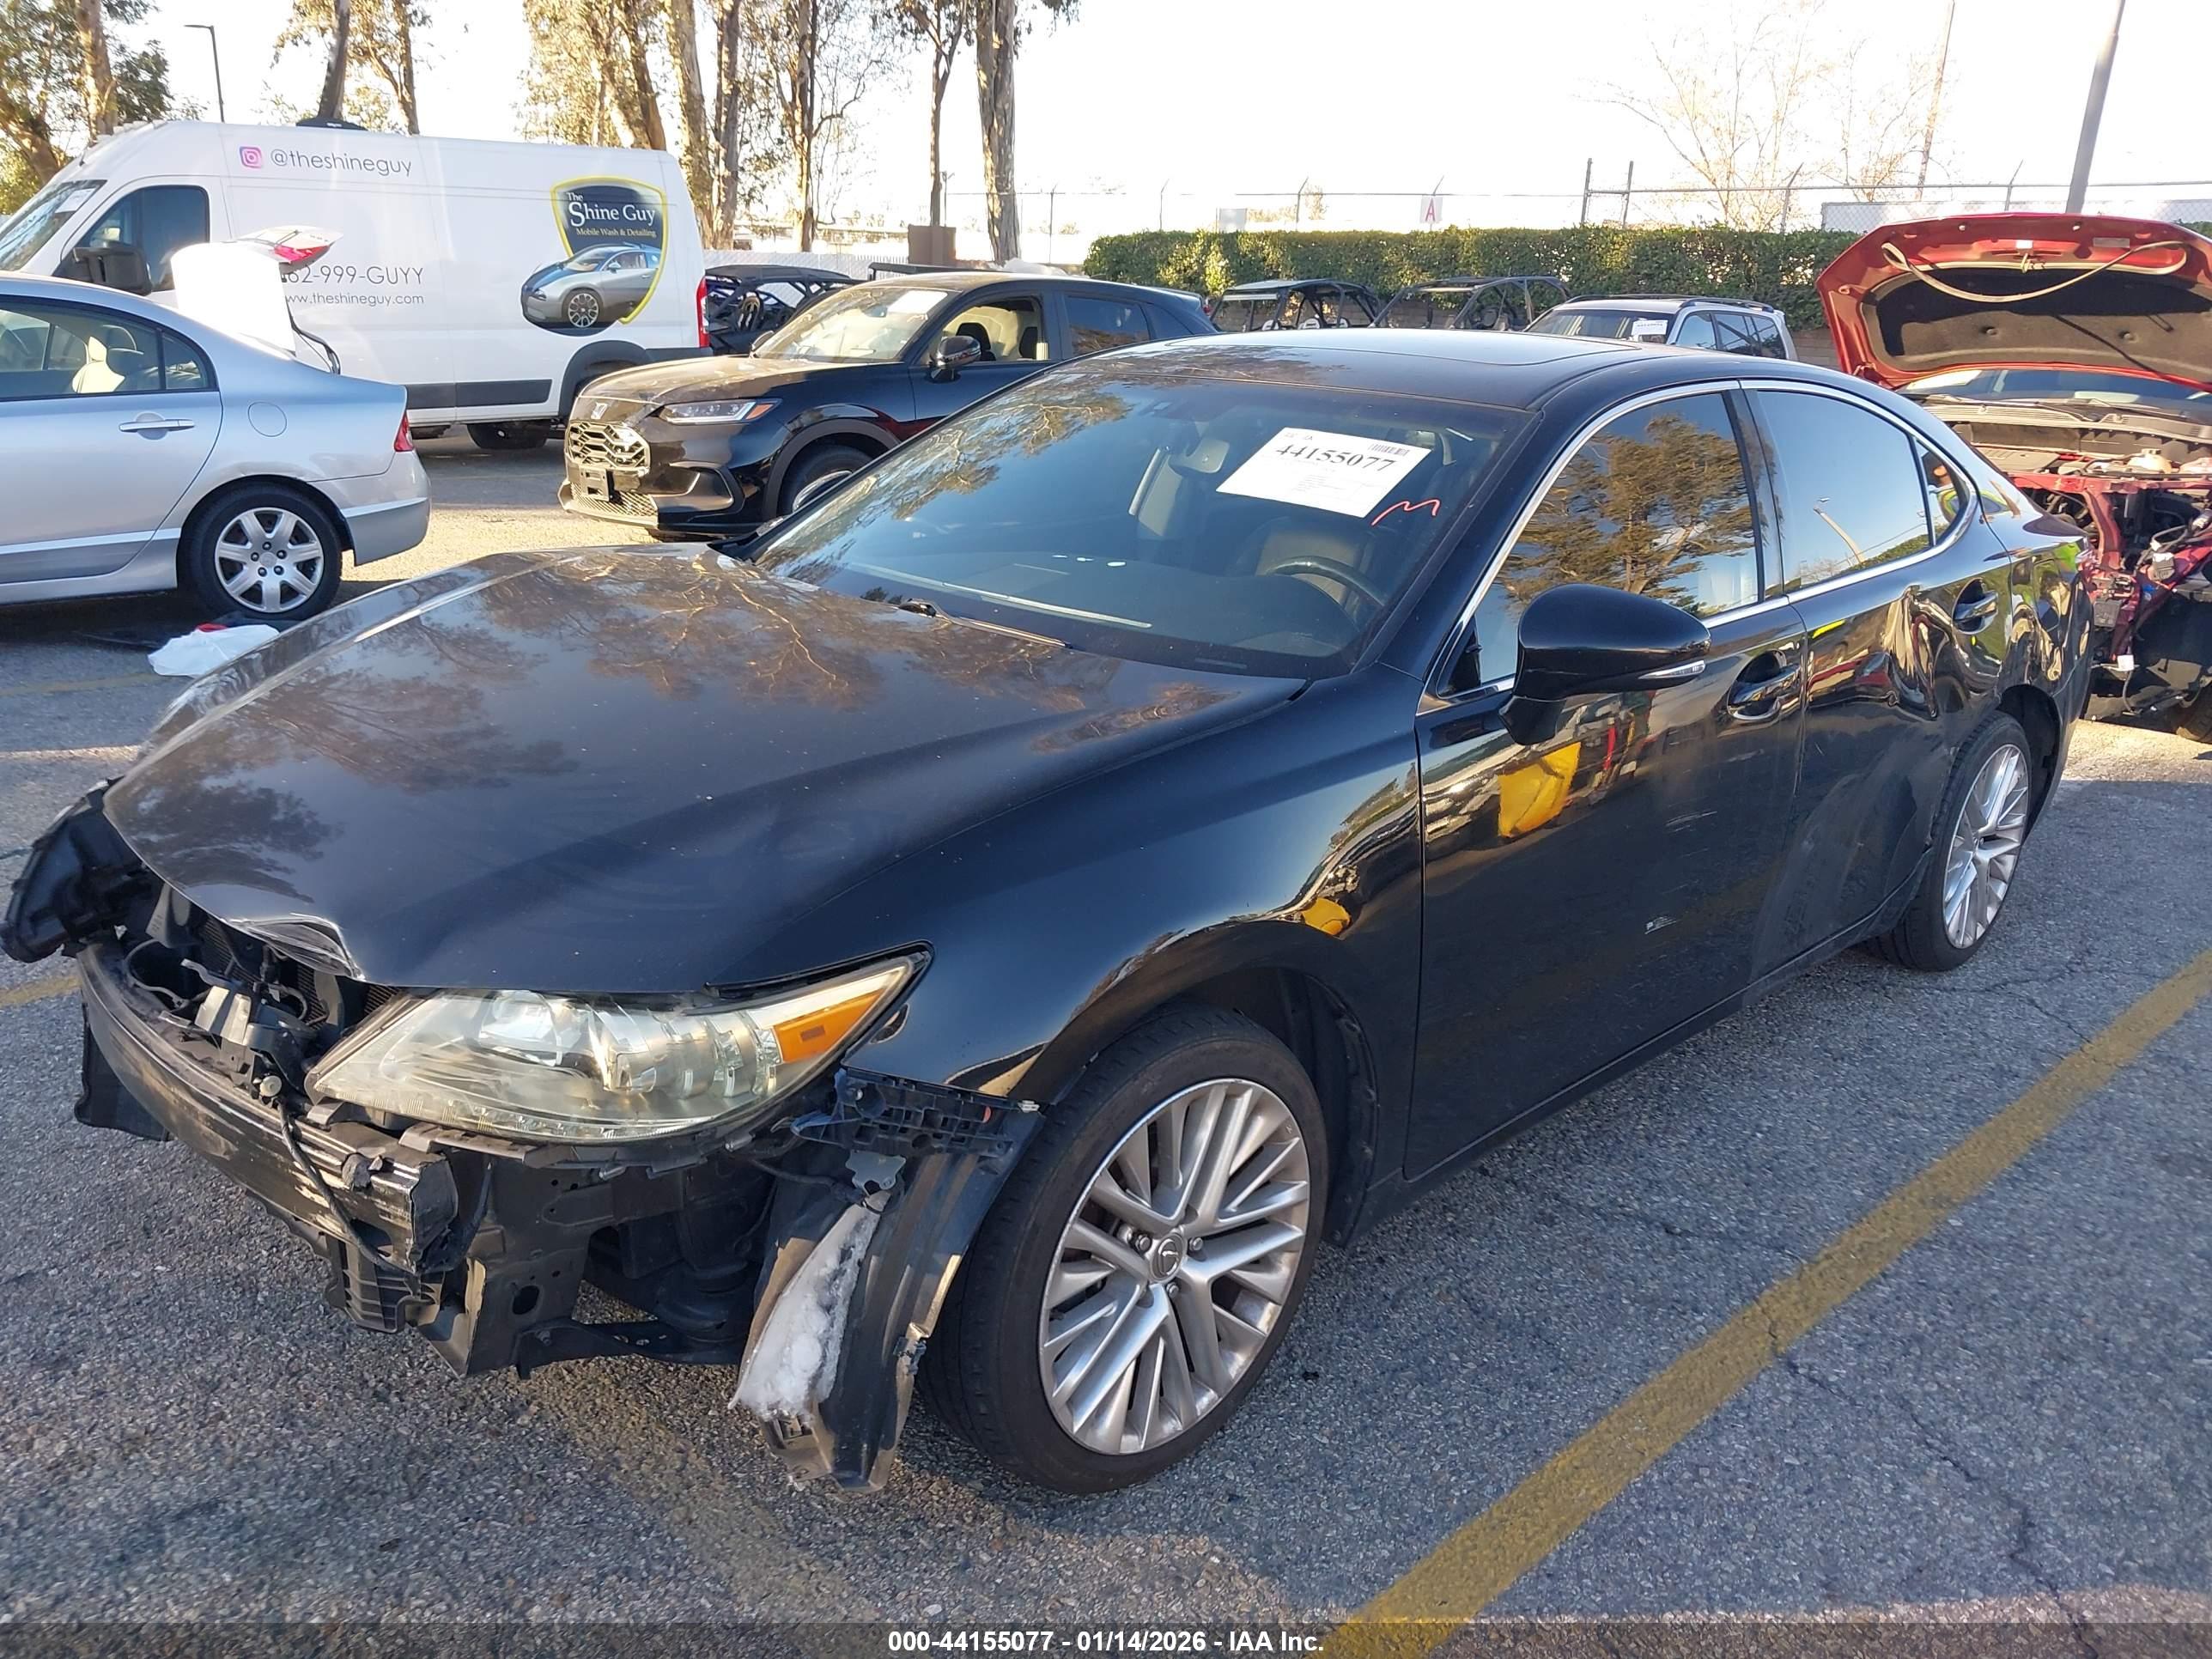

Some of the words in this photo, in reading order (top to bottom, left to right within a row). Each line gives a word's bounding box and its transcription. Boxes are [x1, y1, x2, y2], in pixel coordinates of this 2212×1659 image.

[270, 149, 411, 176] @theshineguy
[567, 191, 584, 202] The
[568, 201, 619, 227] Shine
[622, 204, 655, 227] Guy
[1425, 198, 1436, 222] A
[576, 227, 599, 236] Mobile
[600, 228, 619, 236] Wash
[626, 228, 657, 239] Detailing
[1275, 444, 1397, 471] 44155077
